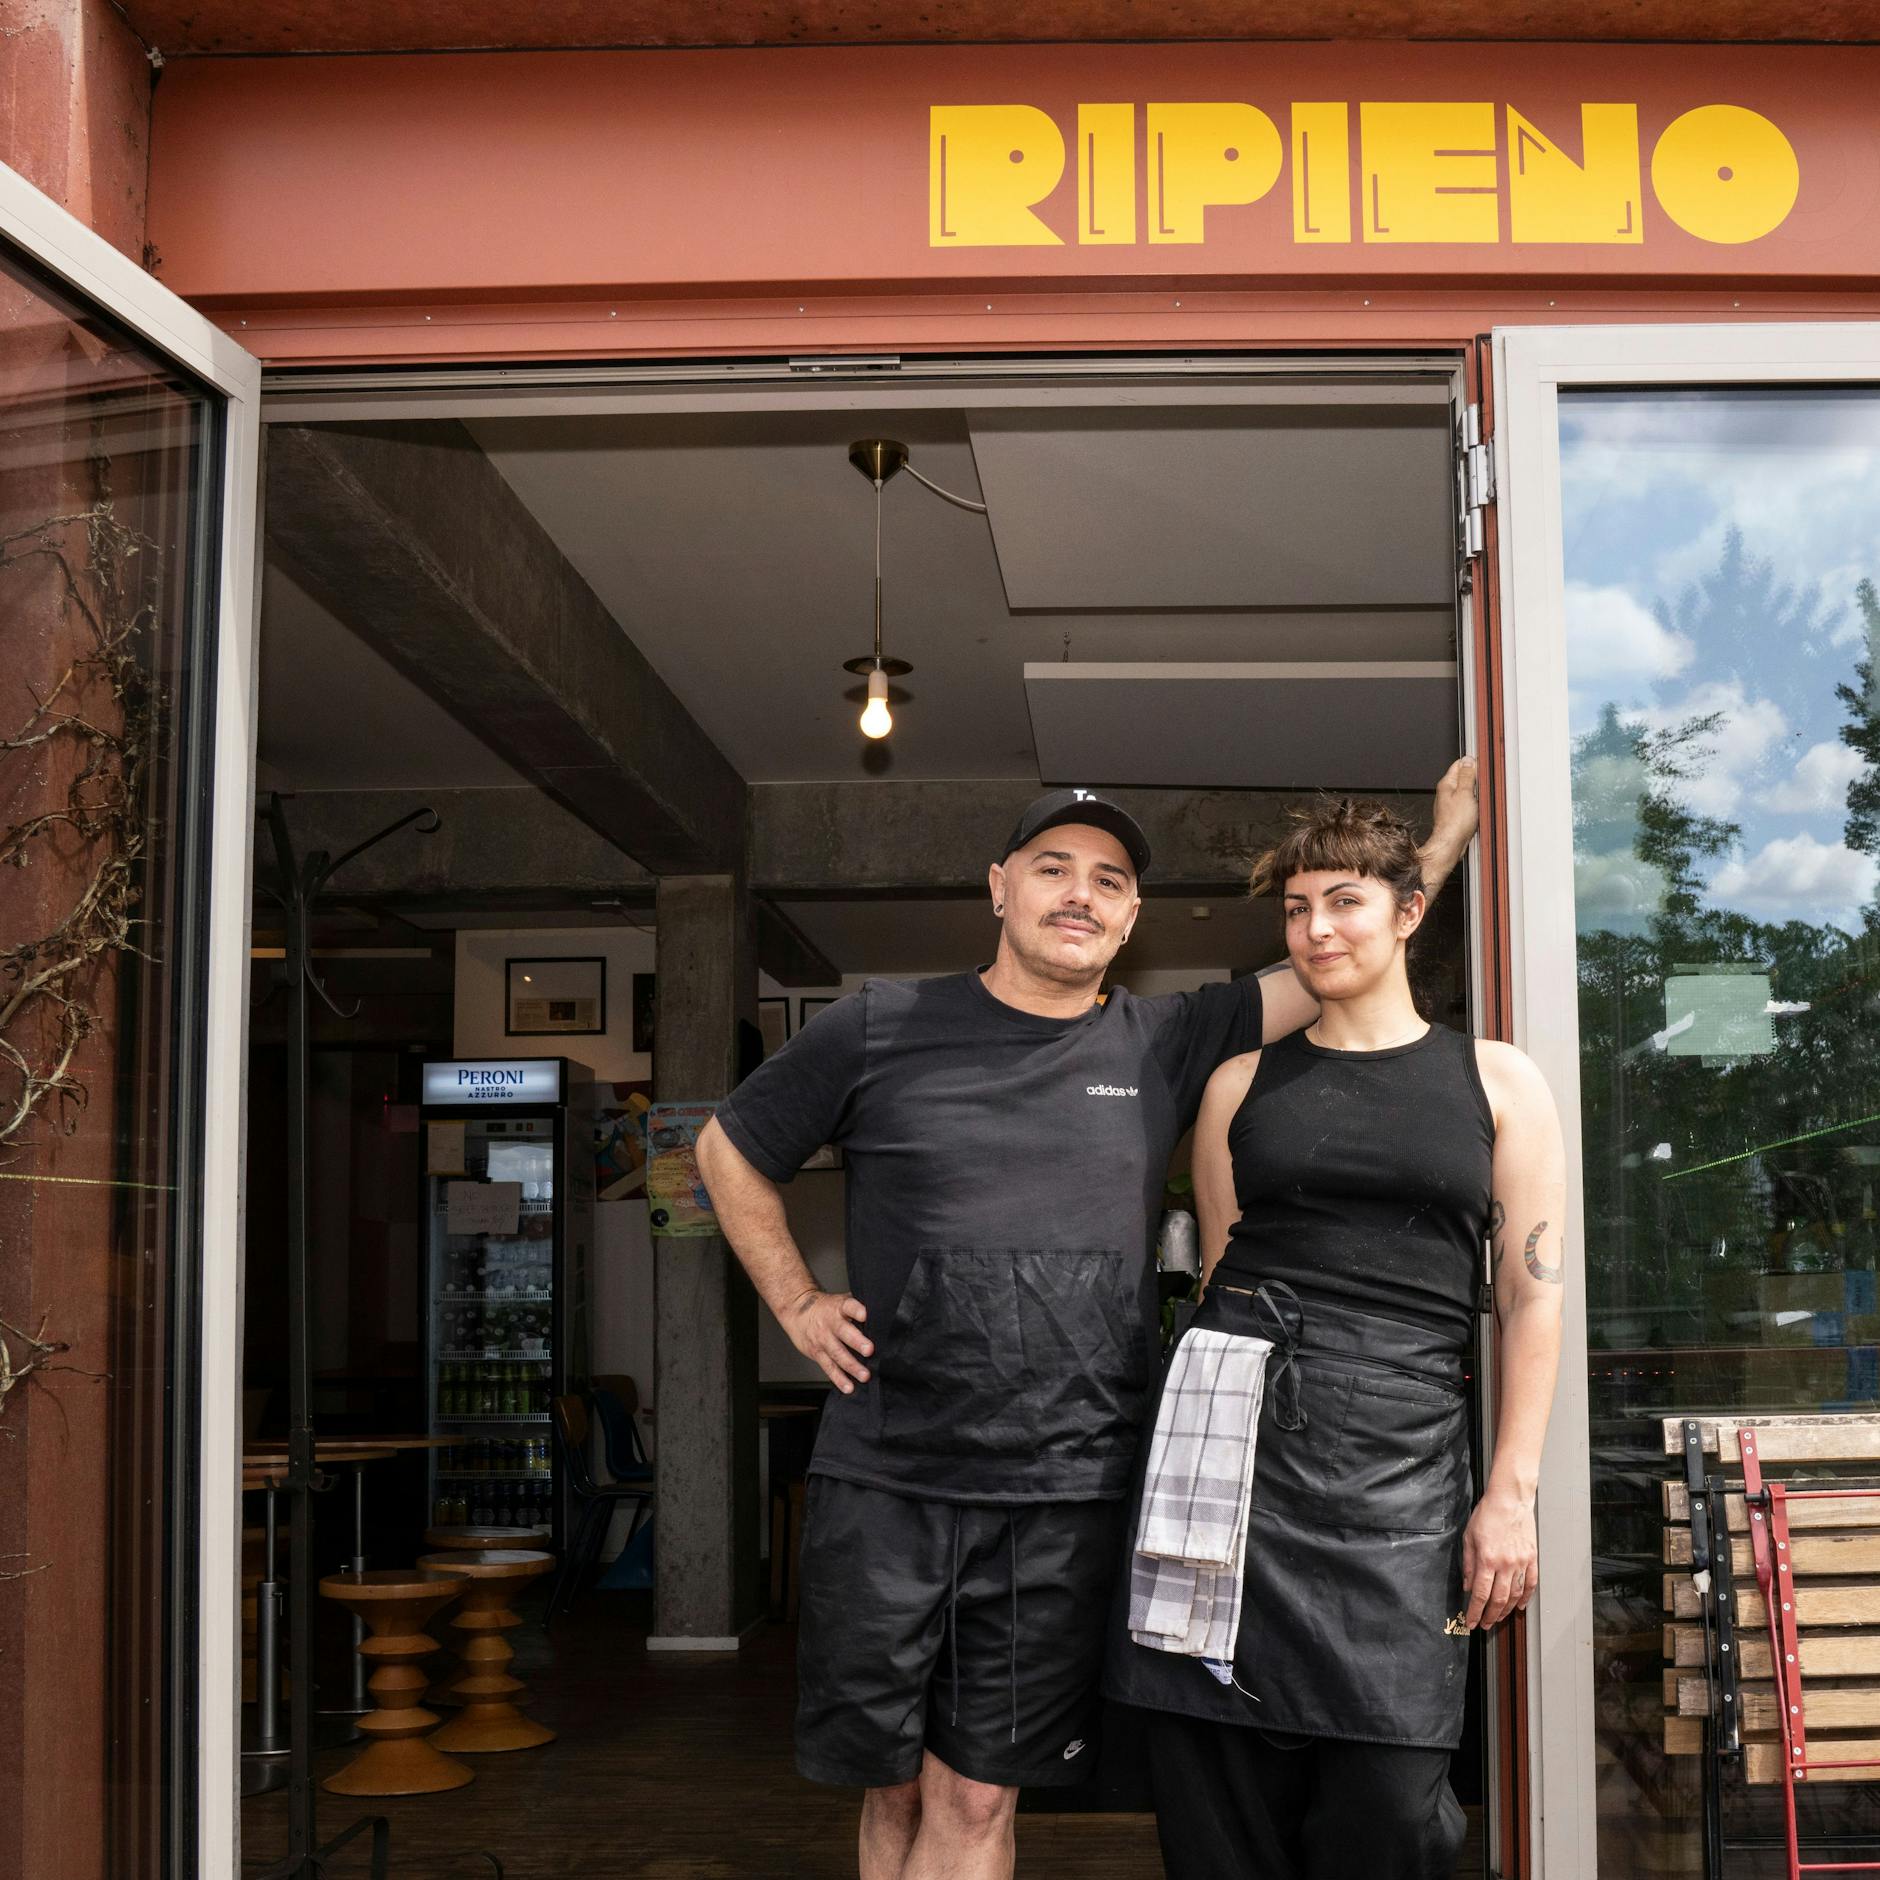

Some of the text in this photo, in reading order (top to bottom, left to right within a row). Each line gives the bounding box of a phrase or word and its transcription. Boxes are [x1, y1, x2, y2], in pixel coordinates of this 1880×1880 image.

[929, 102, 1800, 247] RIPIENO
[458, 1069, 524, 1085] PERONI
[1086, 1084, 1126, 1096] adidas
